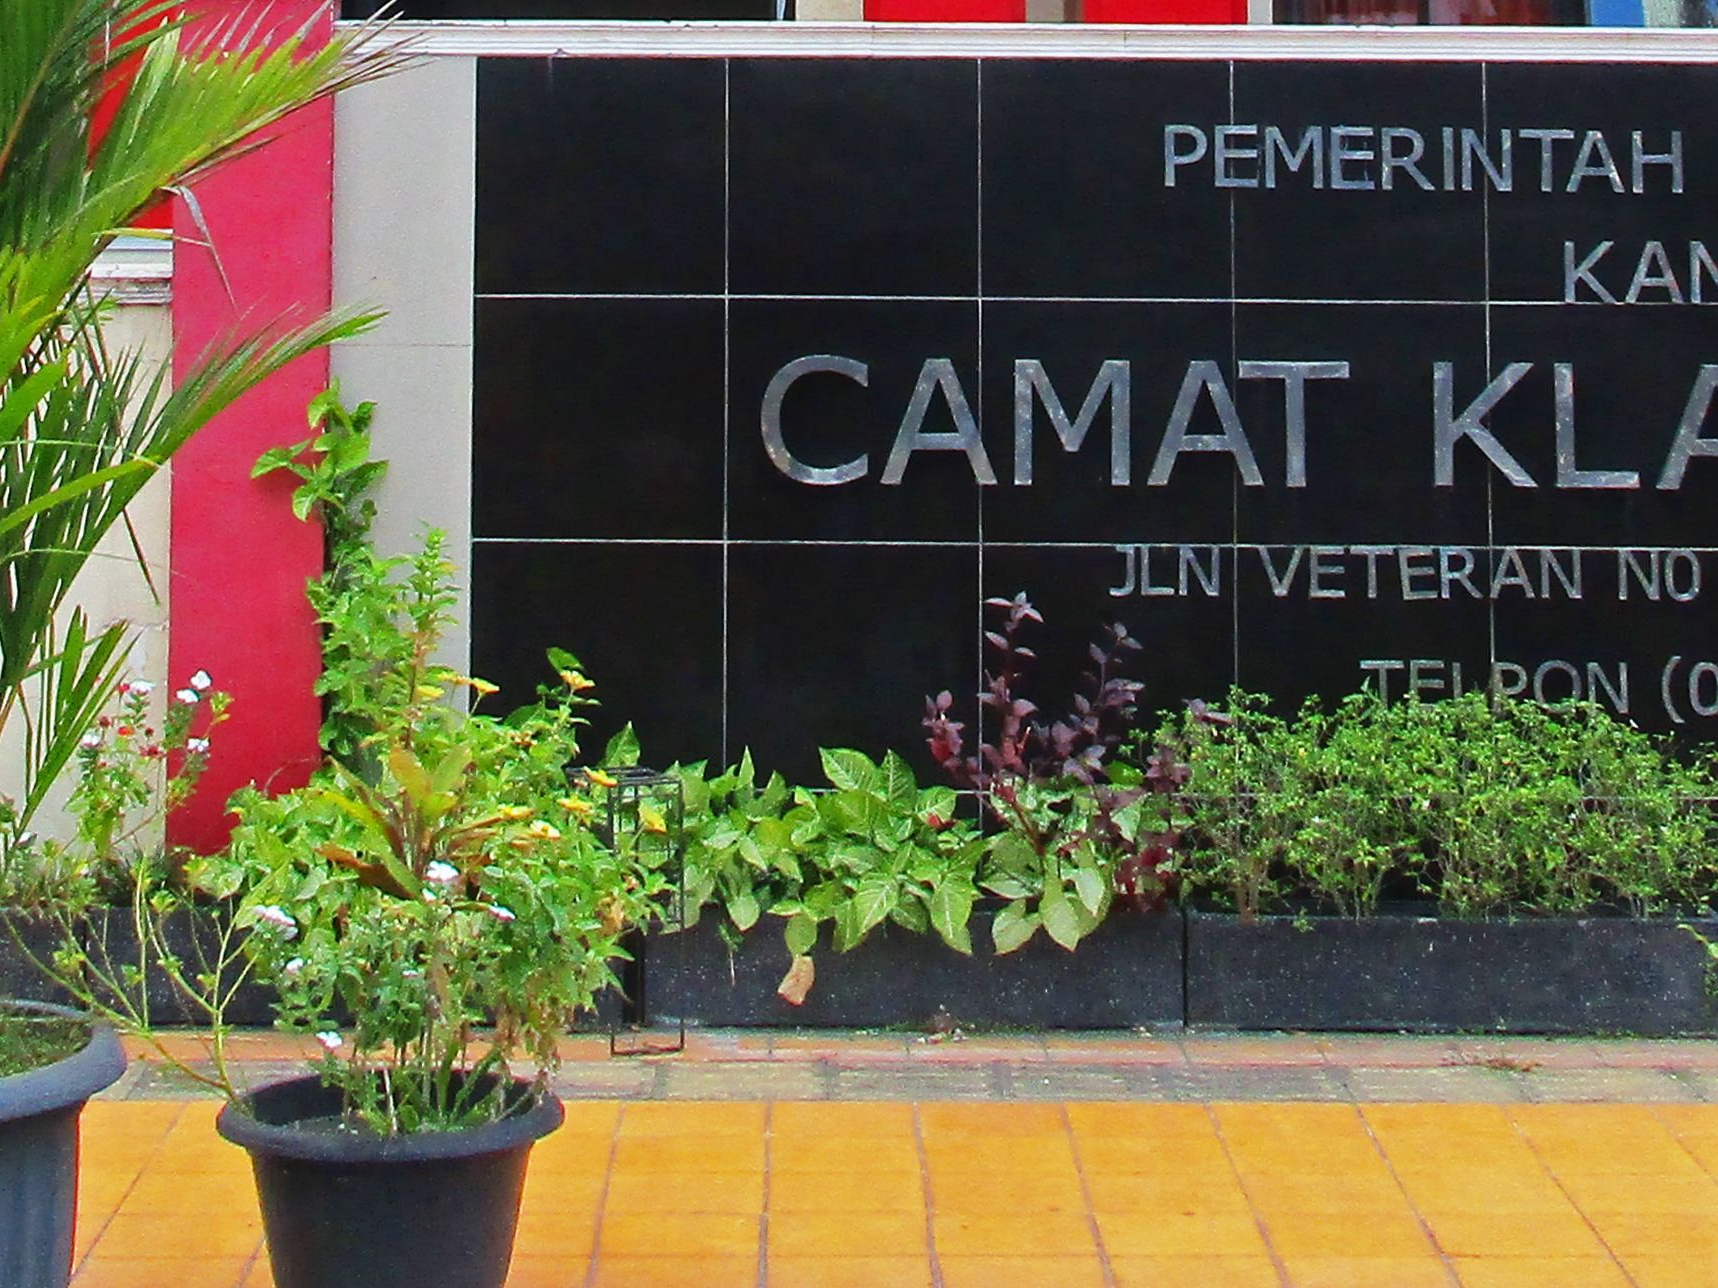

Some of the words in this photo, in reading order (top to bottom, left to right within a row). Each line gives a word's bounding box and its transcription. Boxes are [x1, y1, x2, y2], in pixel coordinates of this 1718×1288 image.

[1164, 124, 1684, 193] PEMERINTAH
[759, 354, 1350, 487] CAMAT
[1109, 545, 1220, 597] JLN
[1258, 545, 1583, 601] VETERAN
